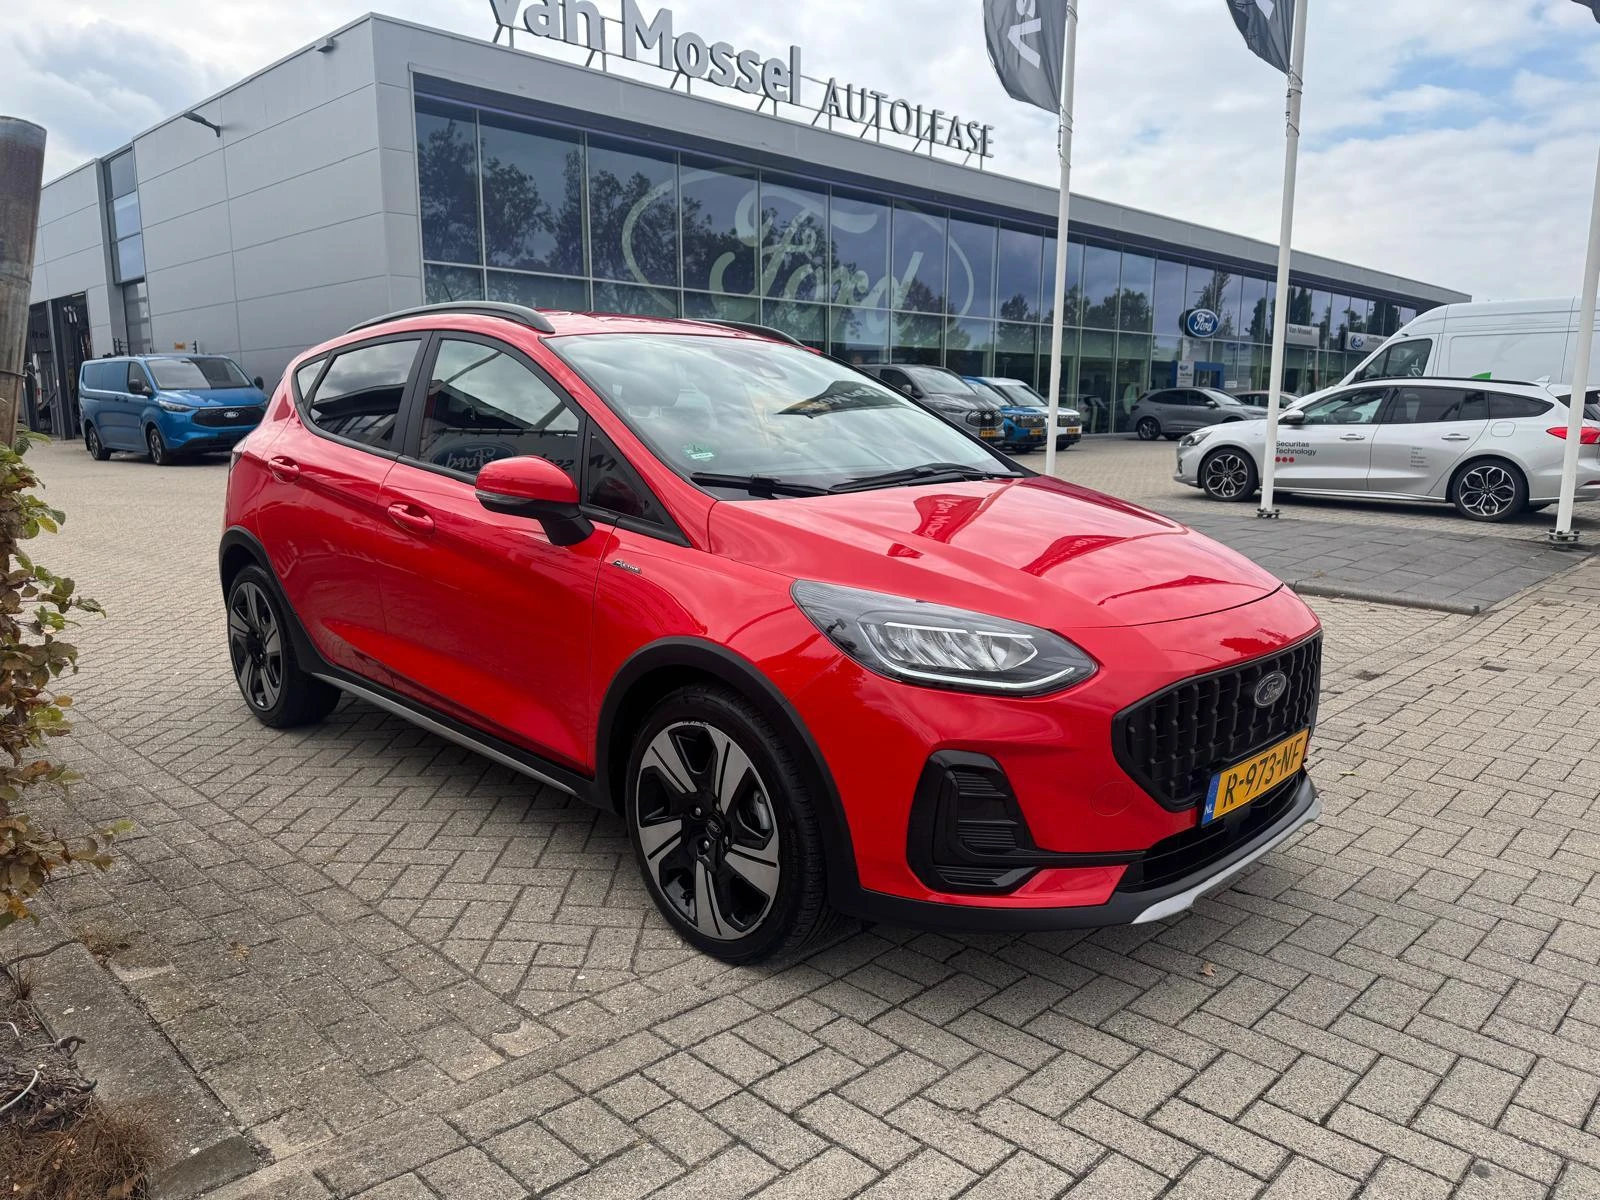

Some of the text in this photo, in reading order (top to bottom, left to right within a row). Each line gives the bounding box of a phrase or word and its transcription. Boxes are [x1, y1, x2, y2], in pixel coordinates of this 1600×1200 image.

[621, 0, 801, 105] Mossel
[821, 77, 995, 158] AUTOLEASE
[1193, 312, 1215, 332] Ford
[1275, 440, 1310, 449] Securitas
[1275, 447, 1318, 457] Technology
[1222, 737, 1304, 809] R-973-NF
[1204, 803, 1214, 816] NL
